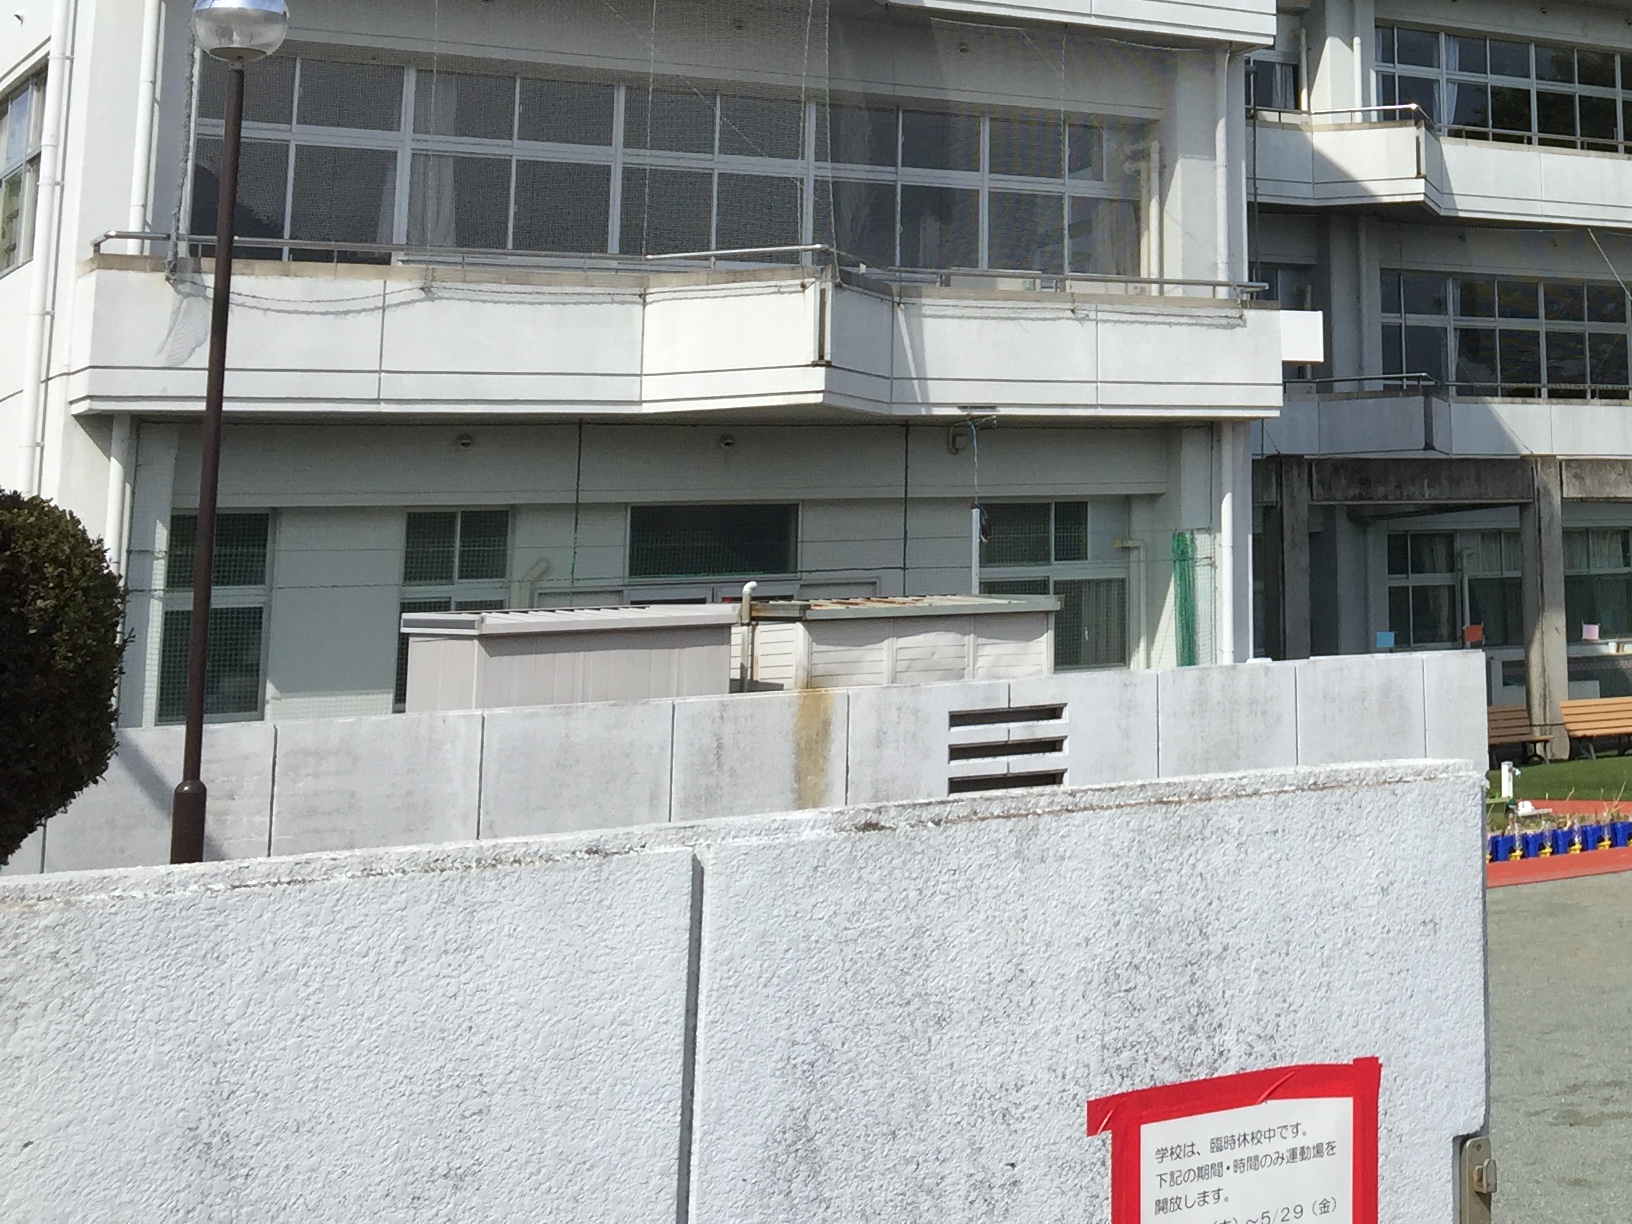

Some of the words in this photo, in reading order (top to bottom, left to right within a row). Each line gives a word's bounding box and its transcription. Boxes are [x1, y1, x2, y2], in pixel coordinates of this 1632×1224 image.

[1154, 1187, 1229, 1215] 開放します。
